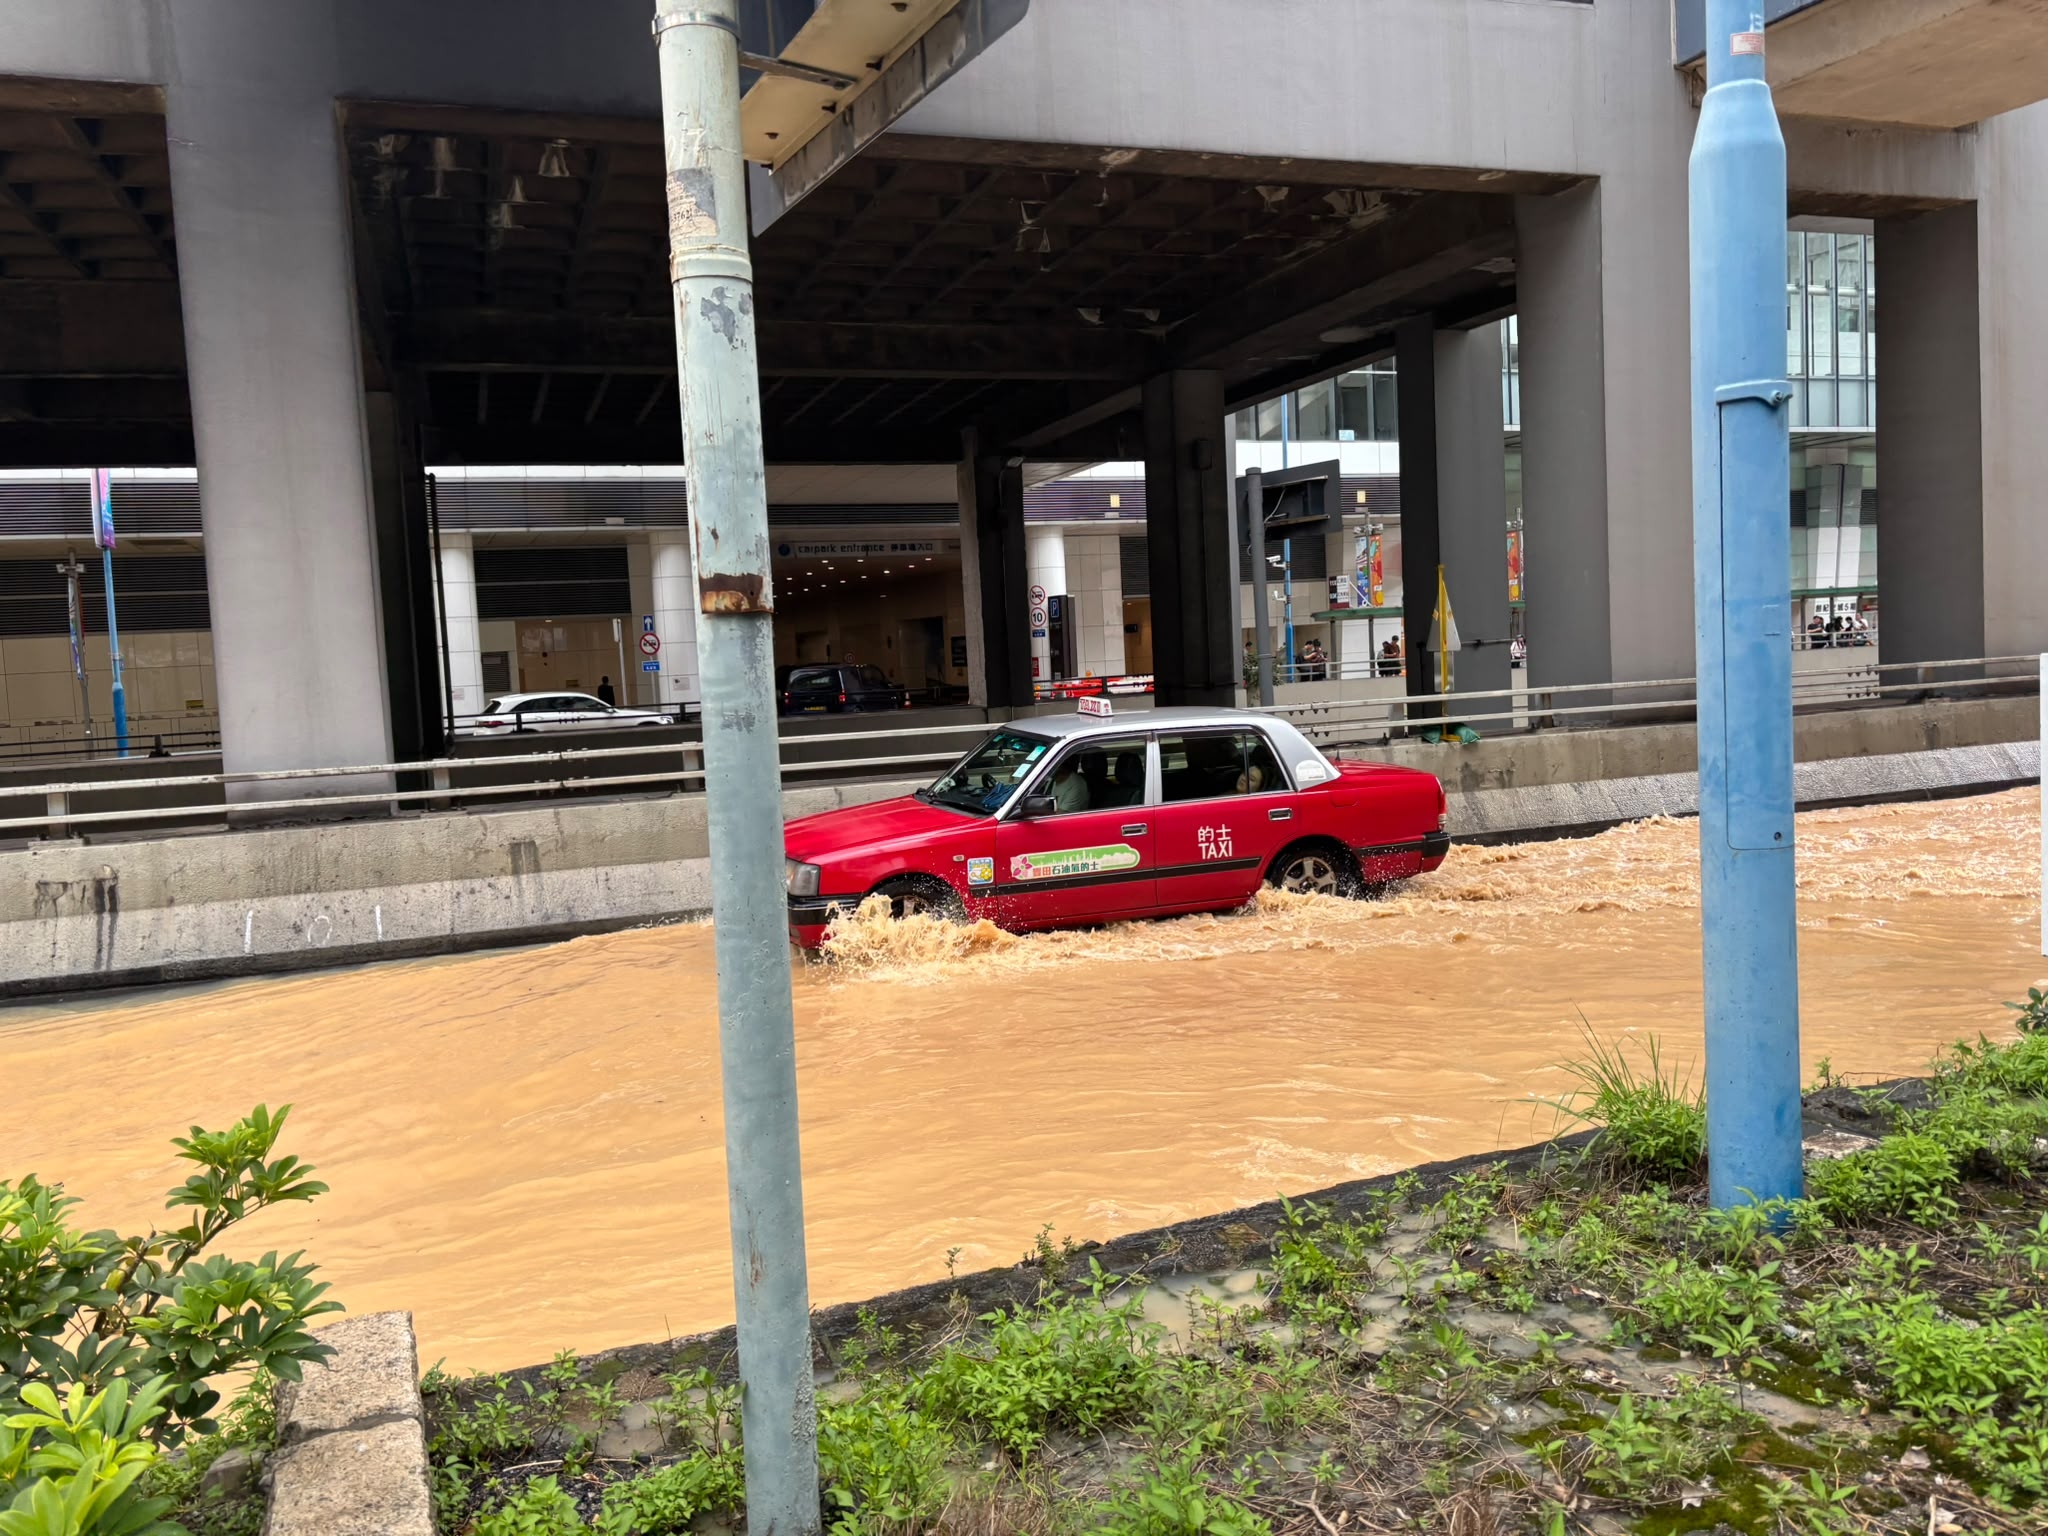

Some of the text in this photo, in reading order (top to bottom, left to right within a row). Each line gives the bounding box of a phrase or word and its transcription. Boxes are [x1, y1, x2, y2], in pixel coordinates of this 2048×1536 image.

[798, 543, 885, 554] carpark entrance
[1032, 612, 1043, 622] 10
[1197, 823, 1232, 842] 的士
[1197, 840, 1233, 860] TAXI
